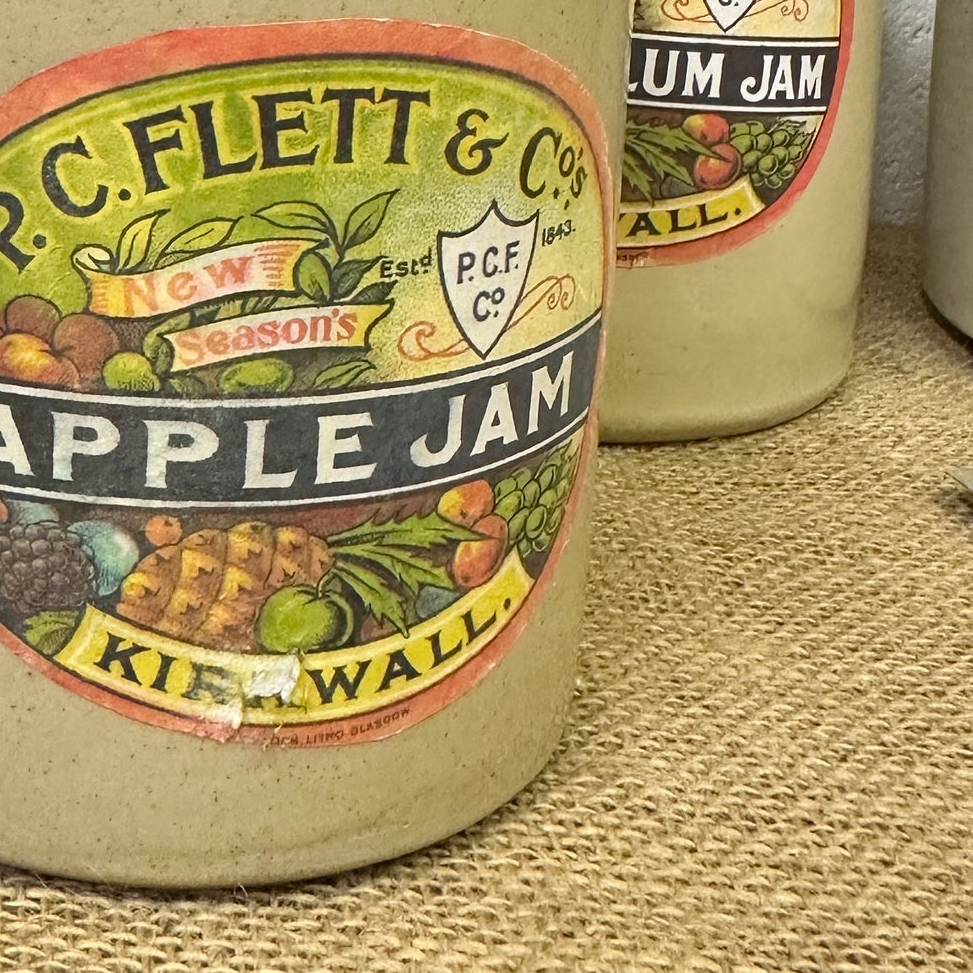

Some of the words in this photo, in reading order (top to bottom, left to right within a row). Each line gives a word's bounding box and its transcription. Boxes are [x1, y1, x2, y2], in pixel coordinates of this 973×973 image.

[628, 47, 726, 100] UM
[740, 54, 826, 103] JAM
[444, 108, 509, 176] &
[123, 251, 256, 316] New
[175, 306, 359, 369] Season's
[409, 353, 574, 470] JAM
